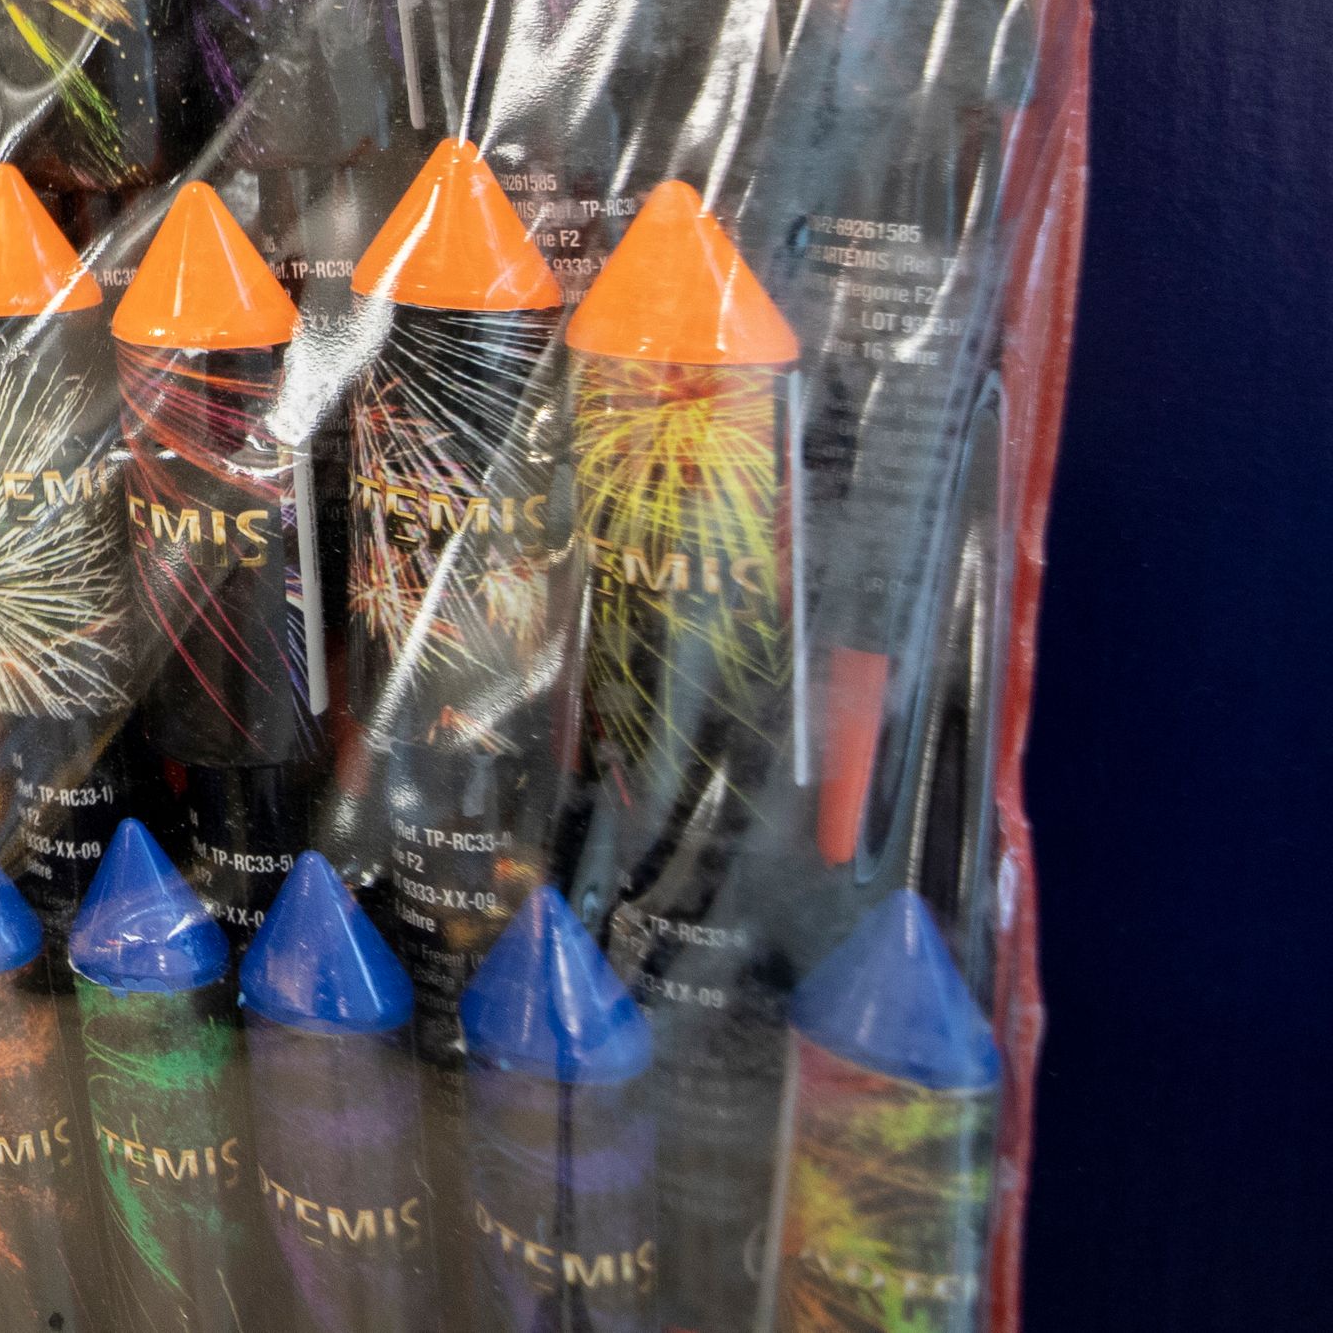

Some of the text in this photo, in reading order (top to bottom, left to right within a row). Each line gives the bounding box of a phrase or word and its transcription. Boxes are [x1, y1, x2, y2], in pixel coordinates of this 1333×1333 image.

[559, 230, 582, 248] F2
[862, 311, 897, 331] LOT
[38, 784, 115, 806] TP-RC33-1)
[406, 850, 425, 873] F2
